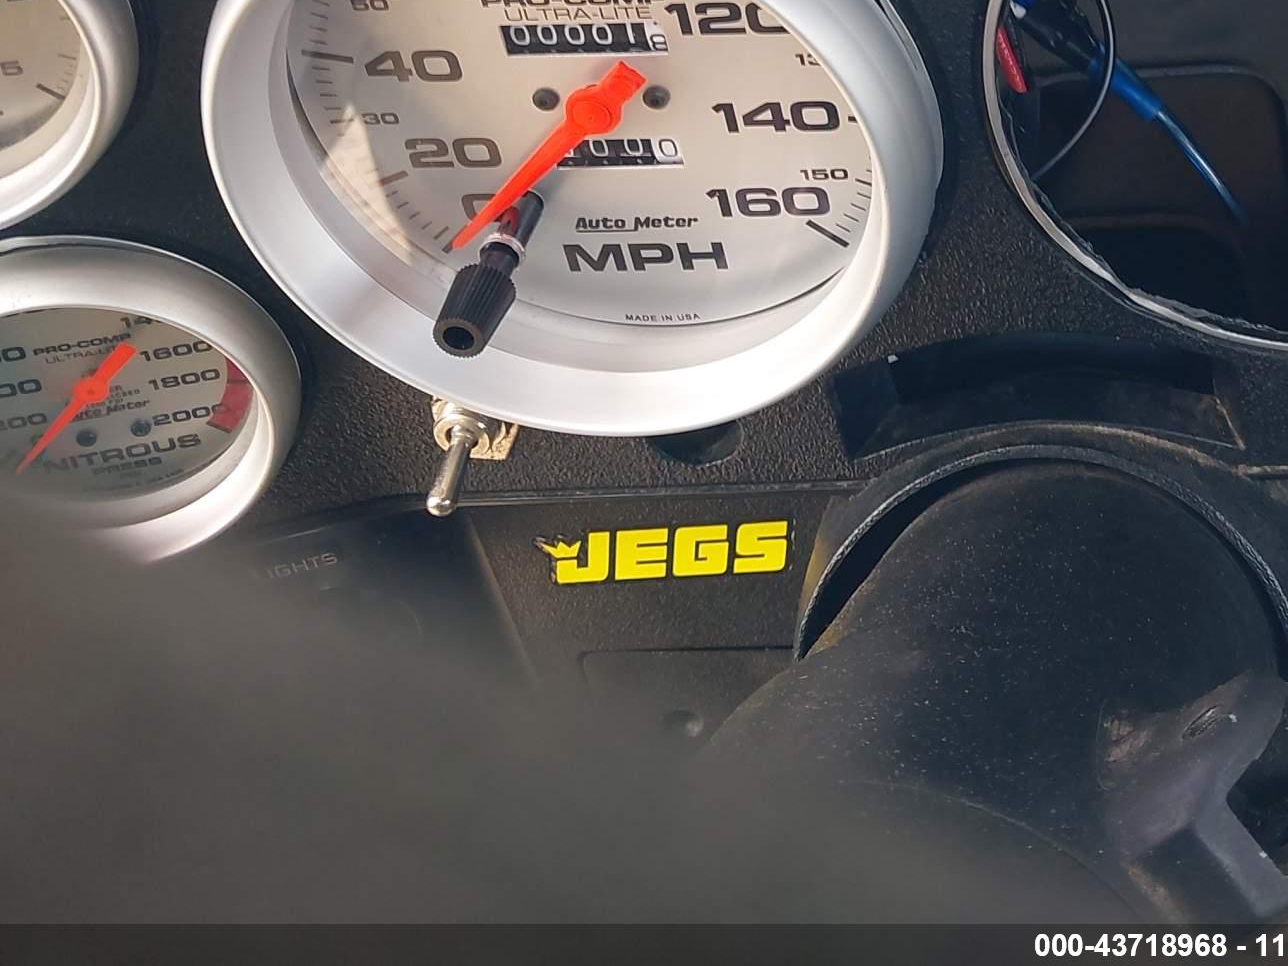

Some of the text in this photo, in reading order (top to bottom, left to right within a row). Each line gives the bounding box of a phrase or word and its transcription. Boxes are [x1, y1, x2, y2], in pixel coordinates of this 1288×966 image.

[504, 6, 653, 22] ULTRA-LITE
[665, 2, 790, 35] 120
[364, 50, 463, 82] 40
[362, 112, 400, 126] 30
[711, 101, 841, 134] 140
[404, 137, 502, 168] 20
[800, 168, 849, 181] 150
[705, 187, 832, 218] 160
[575, 216, 699, 233] Auto Meter
[563, 241, 729, 273] MPH
[625, 312, 701, 323] MADE IN USA
[33, 333, 132, 356] PRO-COMP
[139, 340, 214, 362] 1600
[148, 368, 221, 391] 1800
[152, 403, 230, 427] 2000
[44, 433, 202, 472] NITROUS
[556, 519, 790, 587] JEGS
